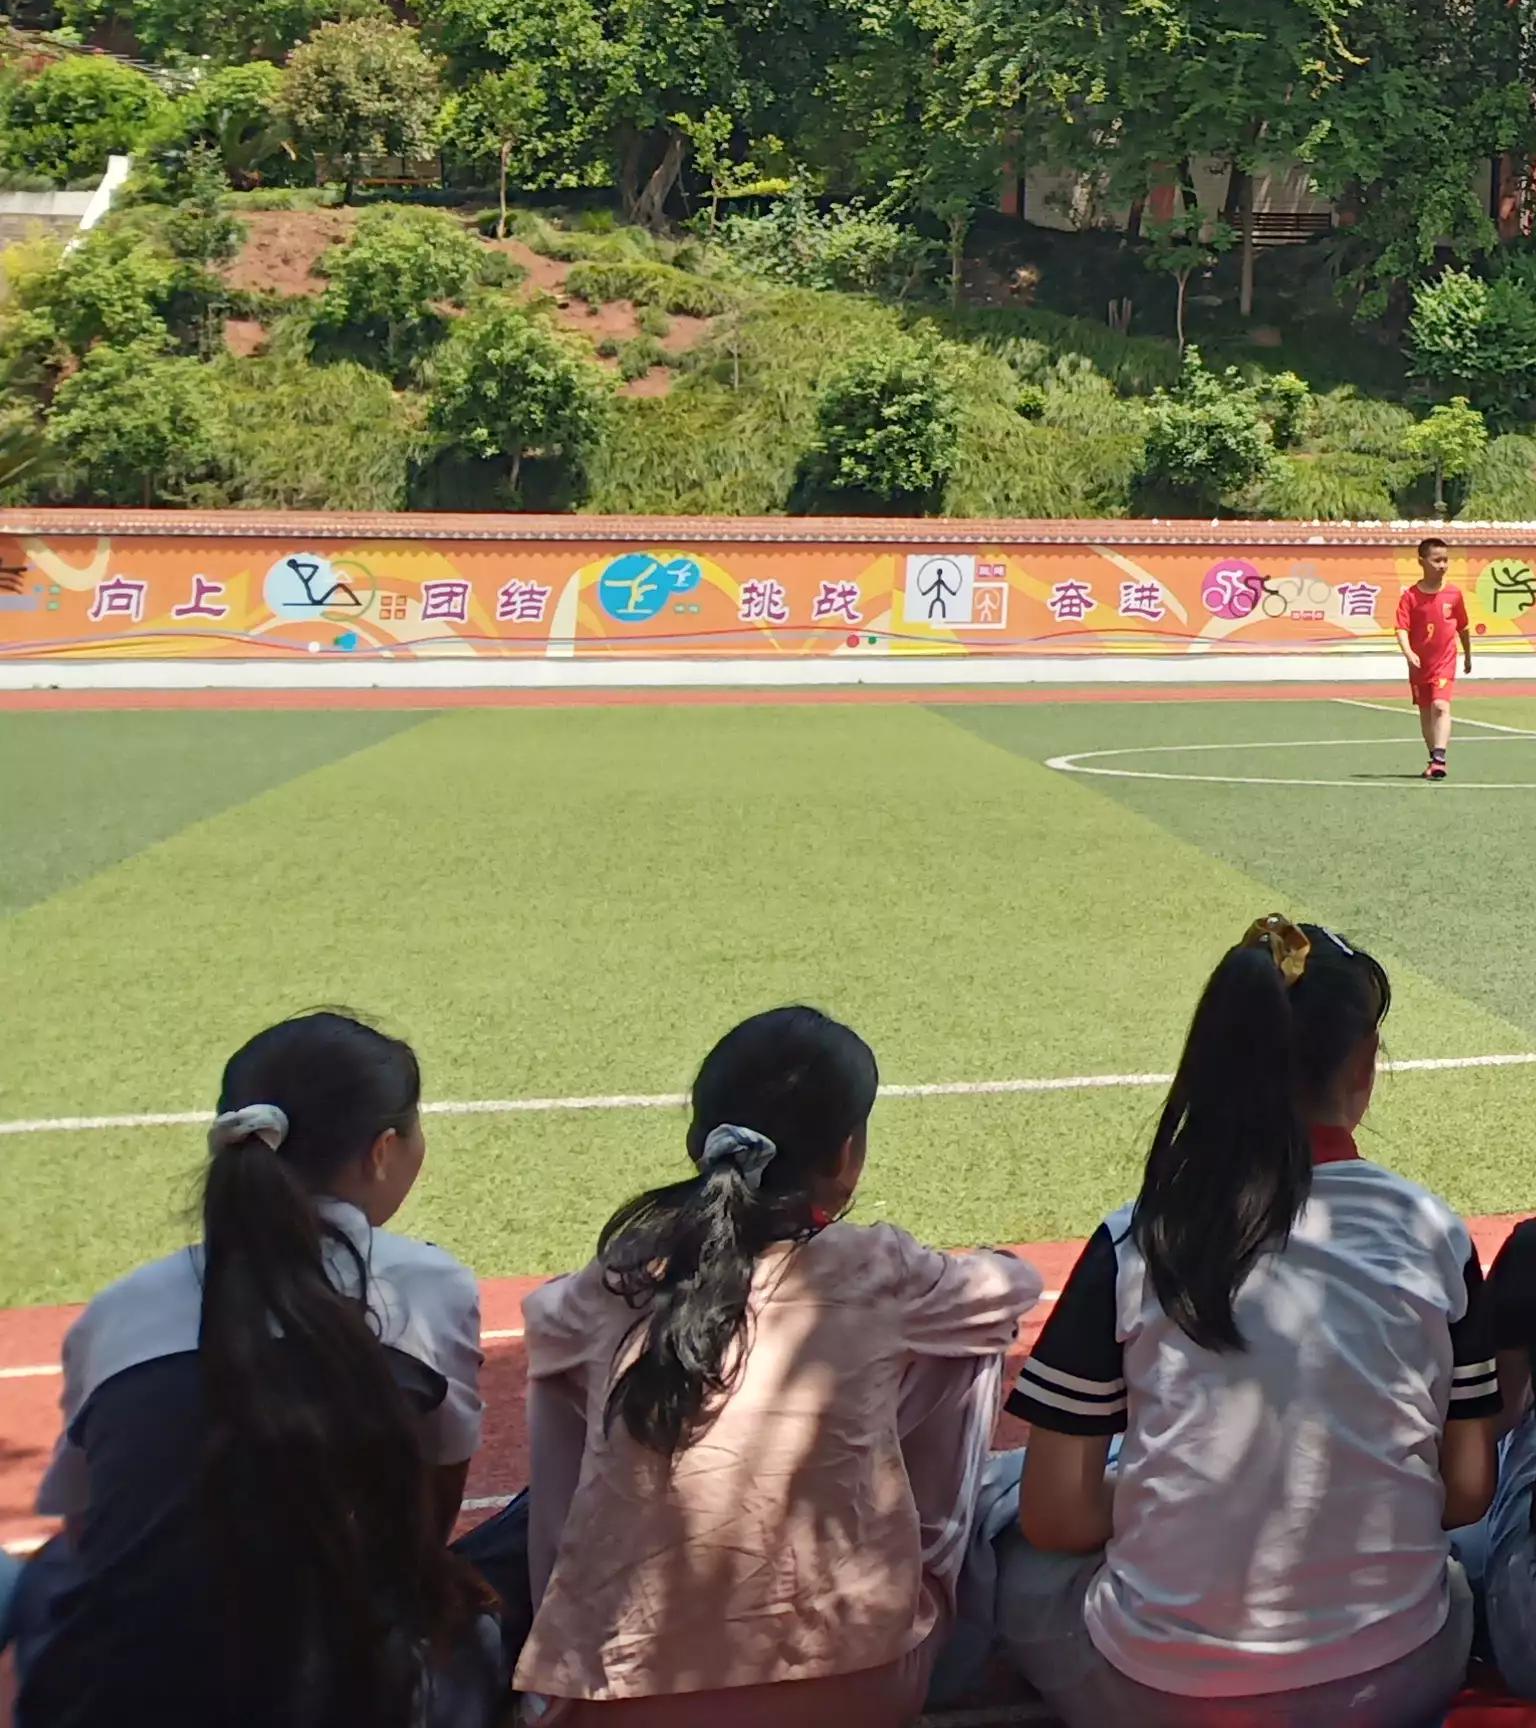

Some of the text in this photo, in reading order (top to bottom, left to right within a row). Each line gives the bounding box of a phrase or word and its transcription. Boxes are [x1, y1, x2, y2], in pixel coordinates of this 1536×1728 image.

[89, 576, 229, 620] 向上
[420, 580, 550, 622] 团结
[740, 581, 861, 621] 挑战
[1048, 581, 1164, 619] 奋进
[1426, 623, 1435, 642] 9
